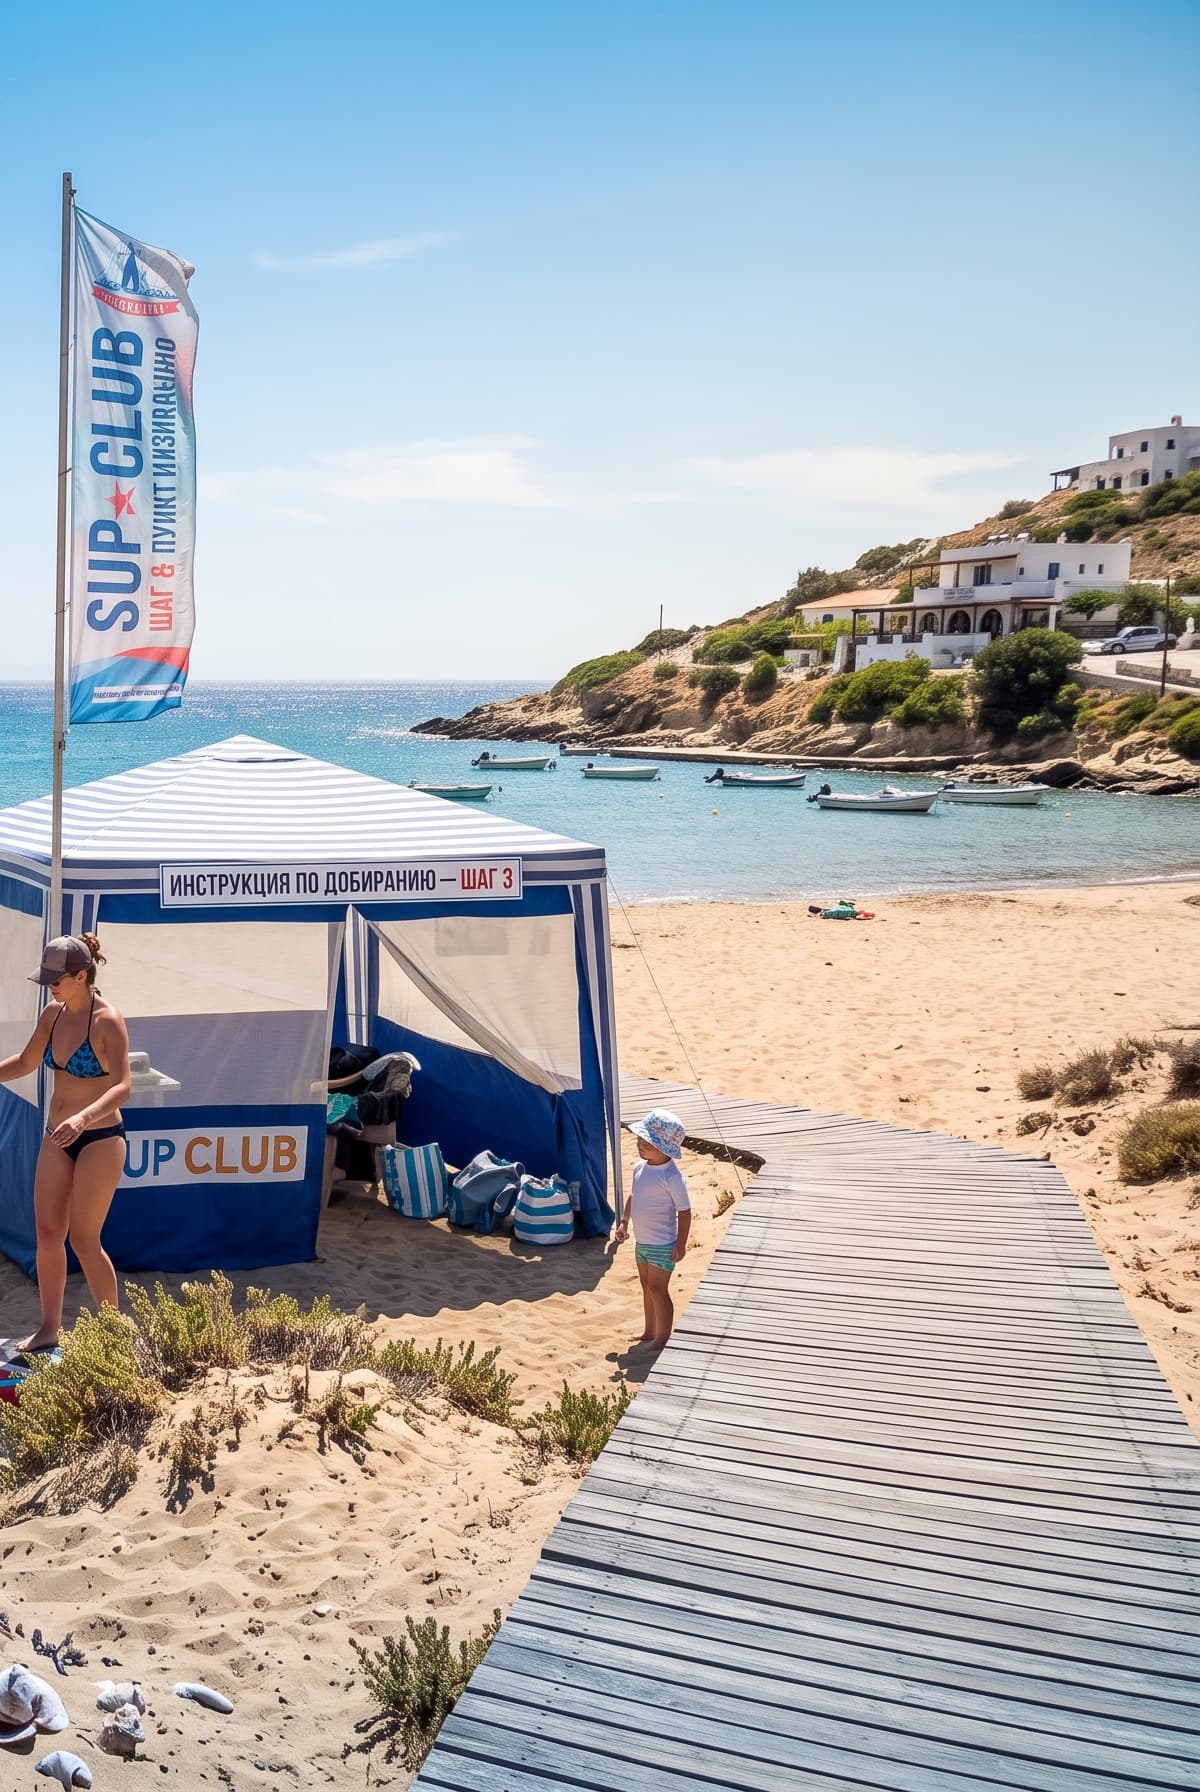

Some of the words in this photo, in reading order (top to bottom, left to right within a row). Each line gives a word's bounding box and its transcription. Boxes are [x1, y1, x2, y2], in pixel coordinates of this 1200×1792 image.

[90, 327, 144, 478] CLUB
[87, 519, 142, 632] SUP
[149, 585, 173, 632] ШАГ
[169, 872, 290, 898] ИНСТРУКЦИЯ
[295, 871, 319, 894] ПО
[324, 869, 437, 896] ДОБИРАНИЮ
[460, 868, 498, 890] ШАГ
[502, 867, 513, 889] 3
[123, 1138, 176, 1179] UP
[184, 1134, 298, 1175] CLUB
